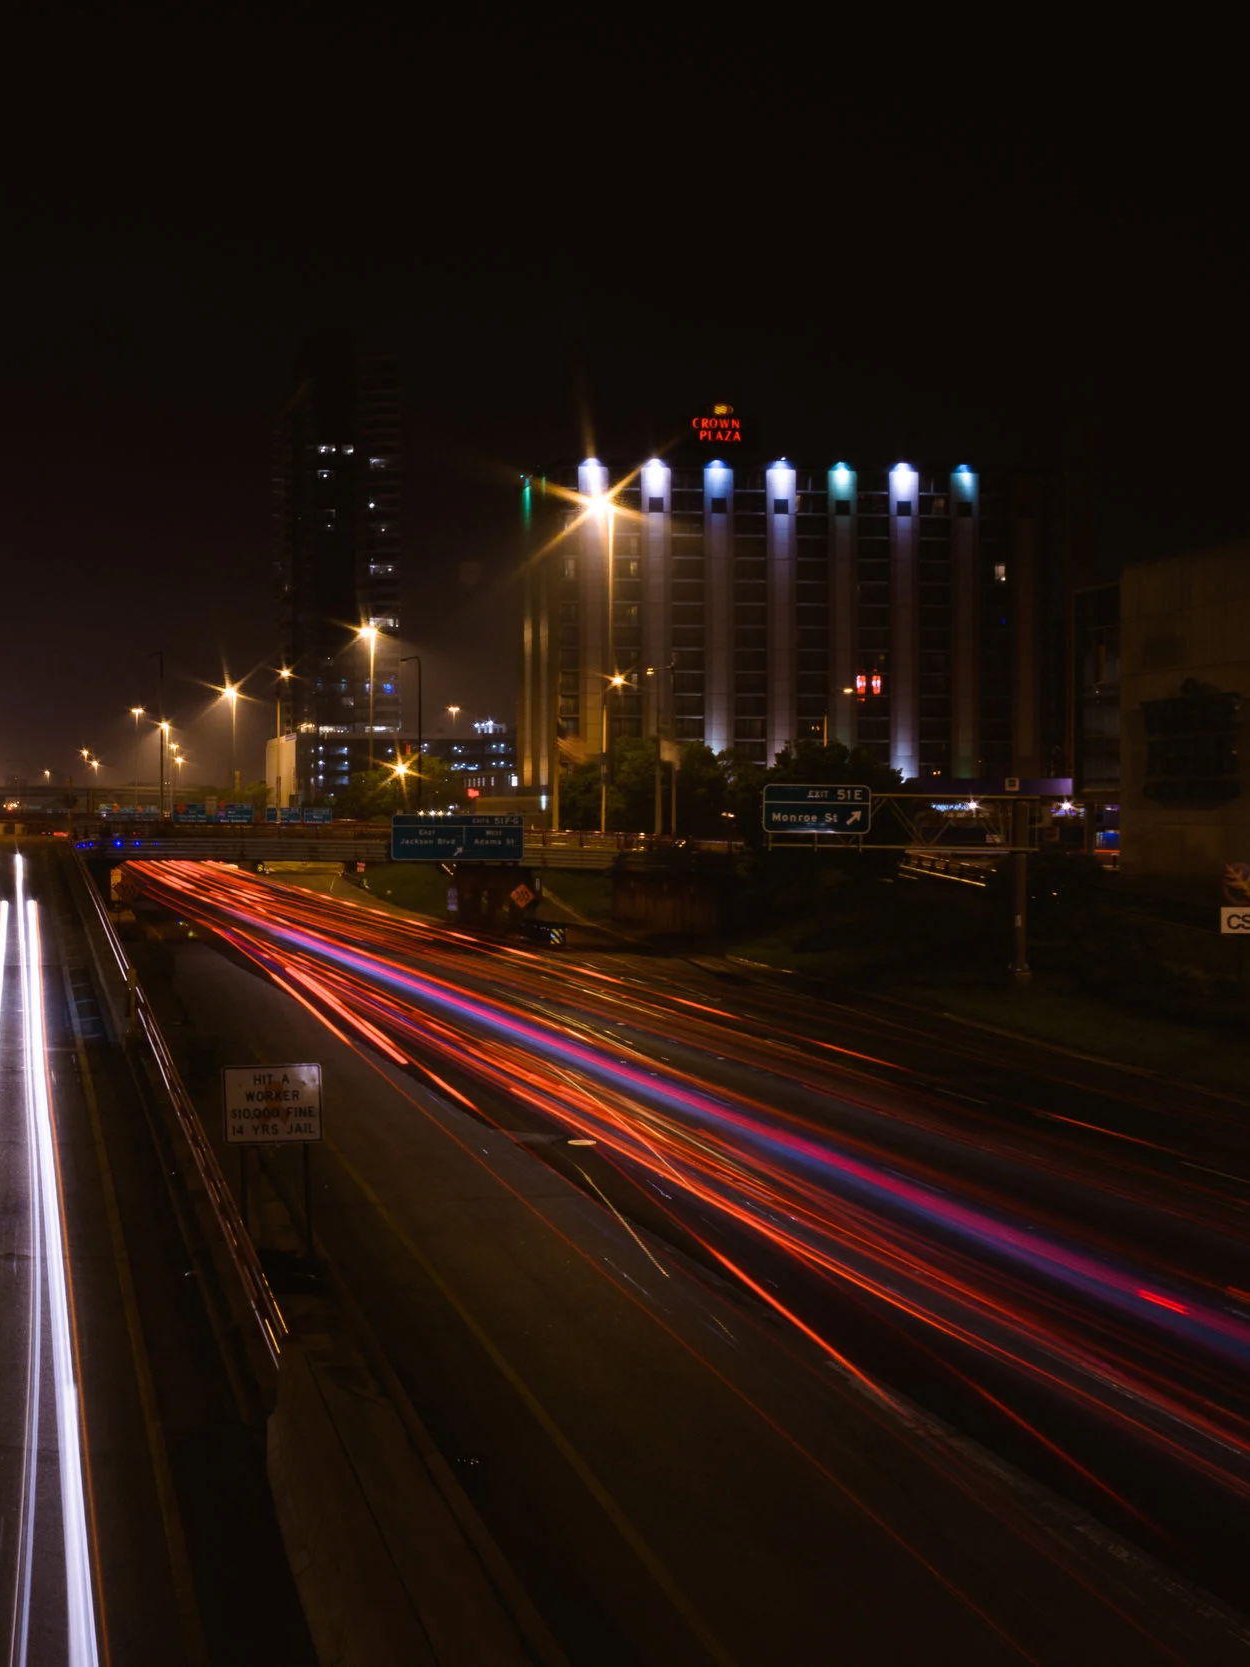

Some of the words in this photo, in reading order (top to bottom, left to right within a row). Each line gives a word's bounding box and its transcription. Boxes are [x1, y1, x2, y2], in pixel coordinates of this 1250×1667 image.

[691, 417, 741, 429] CROWN
[698, 430, 742, 442] PLAZA
[807, 790, 829, 798] EXIT
[837, 789, 863, 800] 51E
[771, 812, 818, 822] Monroe
[824, 812, 839, 823] St
[253, 1074, 273, 1086] HIT
[281, 1074, 290, 1084] A
[245, 1090, 300, 1102] WORKER
[230, 1108, 280, 1120] $10,000
[286, 1106, 316, 1118] FINE
[231, 1125, 244, 1136] 14
[252, 1124, 279, 1136] YRS
[286, 1123, 316, 1135] JAIL
